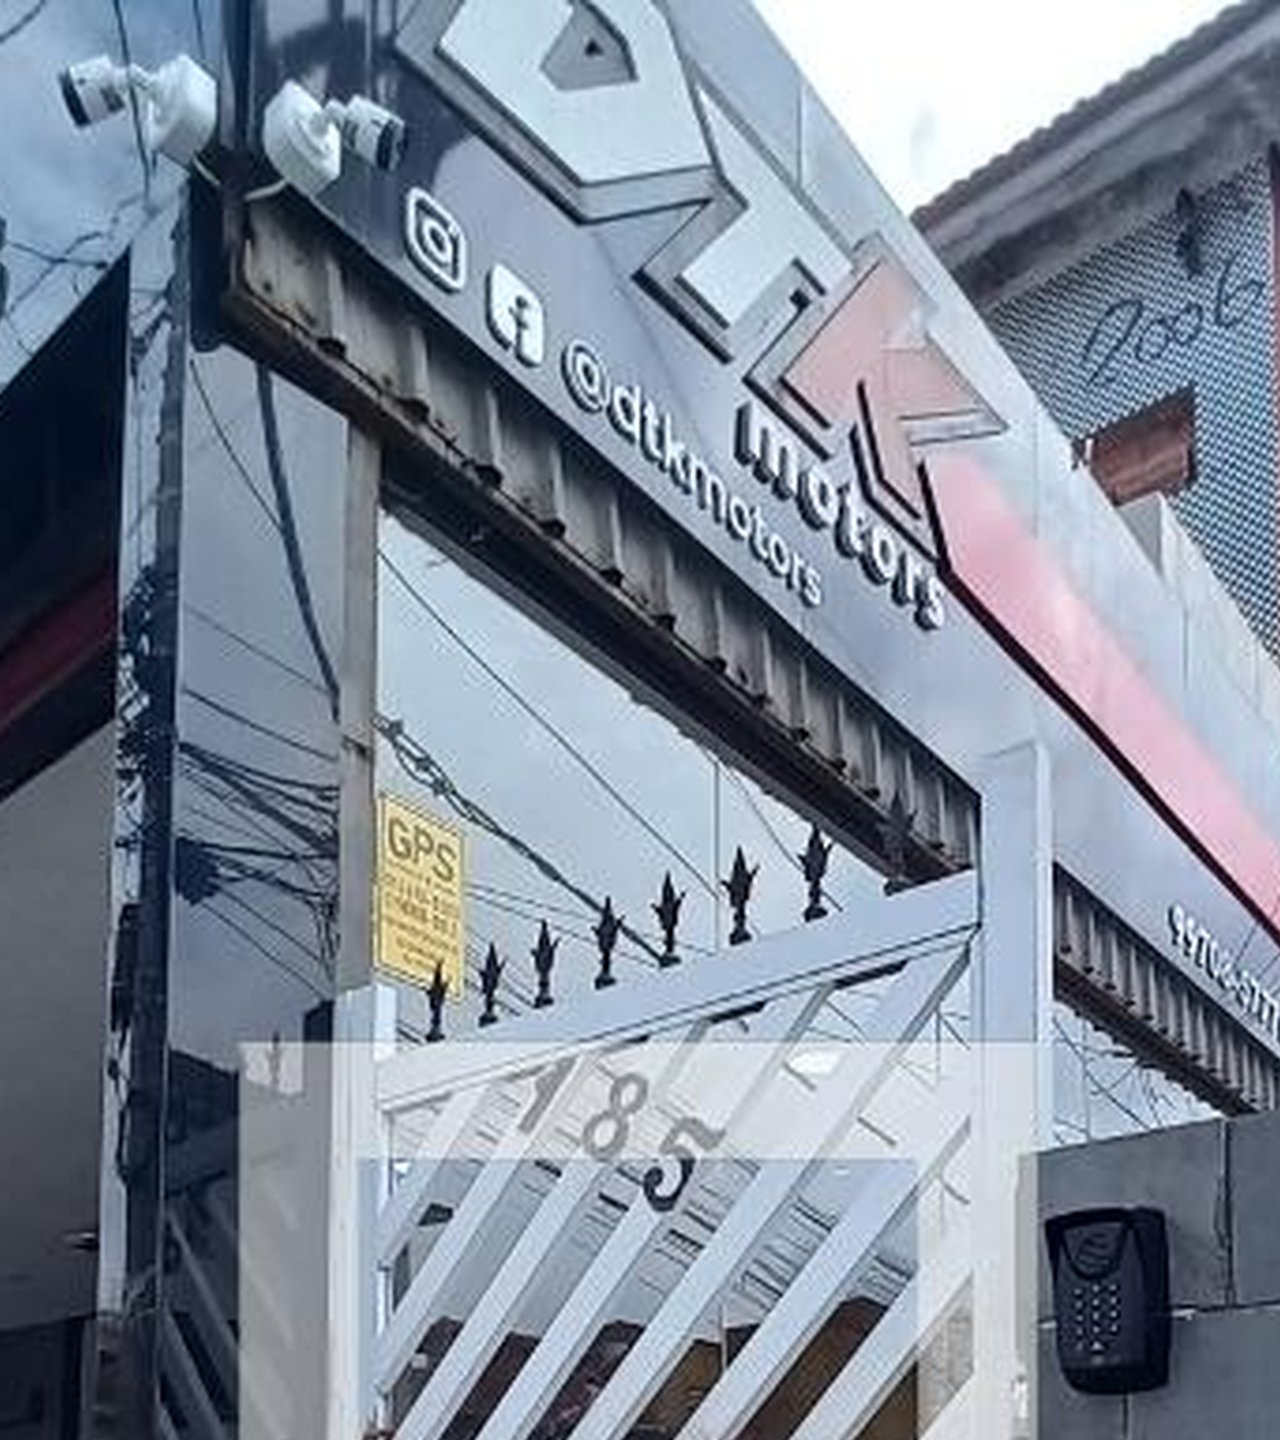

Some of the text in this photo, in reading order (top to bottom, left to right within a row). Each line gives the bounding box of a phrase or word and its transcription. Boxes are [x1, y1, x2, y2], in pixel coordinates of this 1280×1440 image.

[562, 340, 822, 607] @dtkmotors
[733, 400, 946, 631] motors
[387, 817, 458, 883] GPS
[518, 1056, 726, 1213] 185
